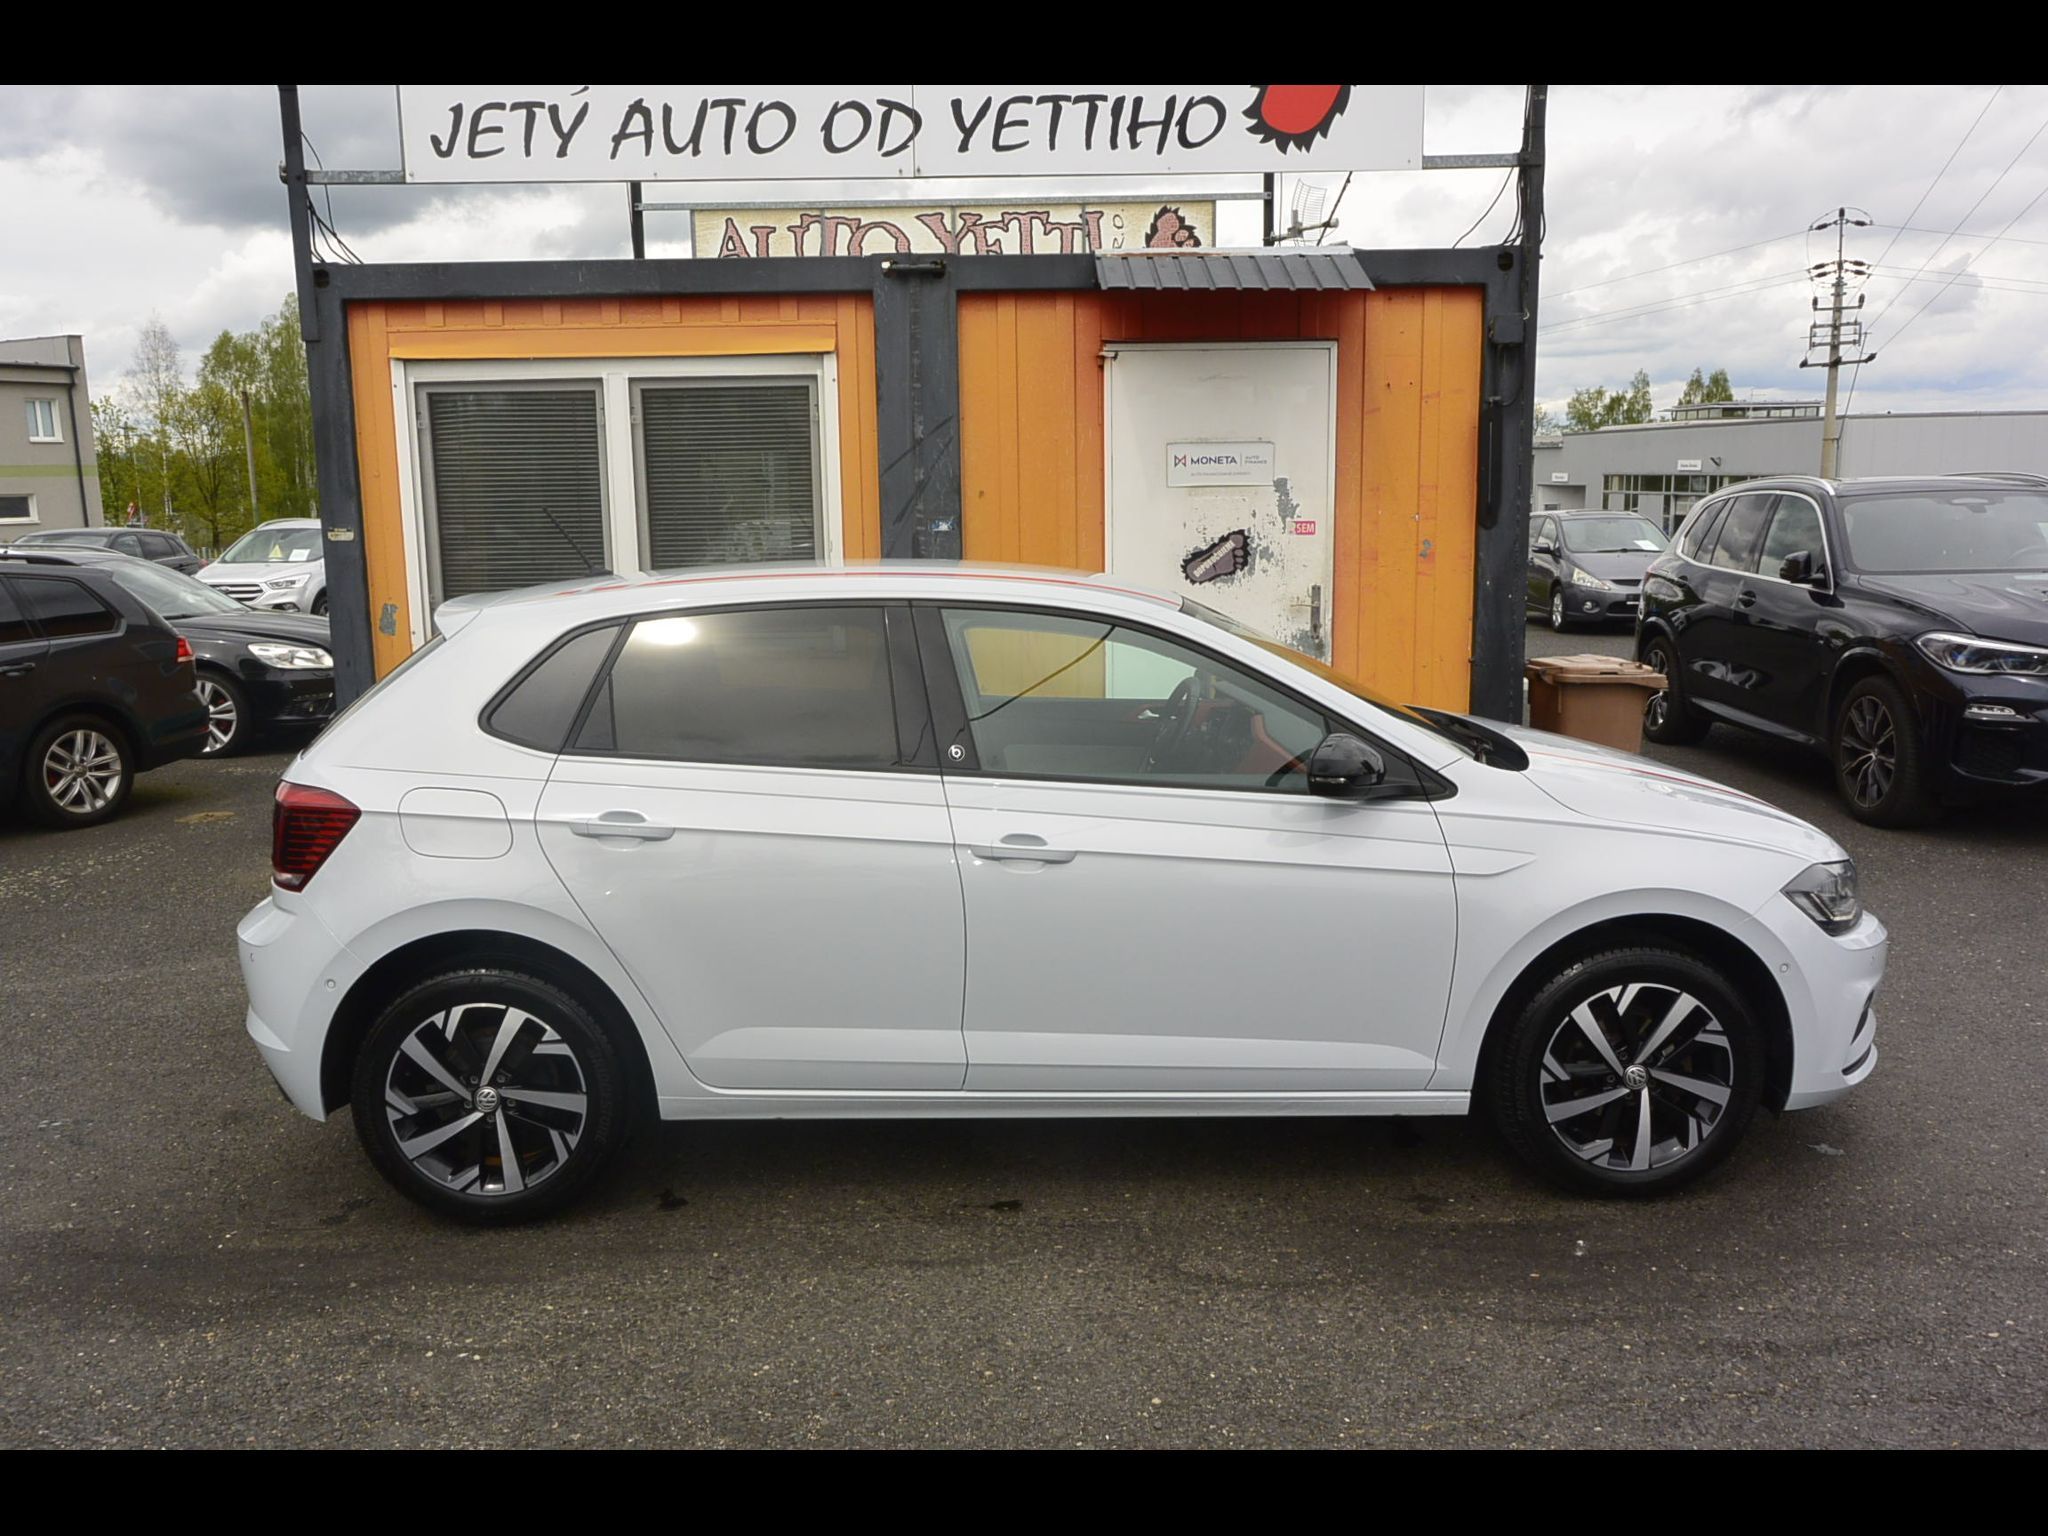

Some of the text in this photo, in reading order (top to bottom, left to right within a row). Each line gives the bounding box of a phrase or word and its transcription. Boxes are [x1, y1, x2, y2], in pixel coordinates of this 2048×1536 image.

[431, 86, 1226, 159] JETÝ AUTO OD YETTIHO
[1191, 455, 1238, 465] MONETA
[1296, 523, 1315, 534] SEM
